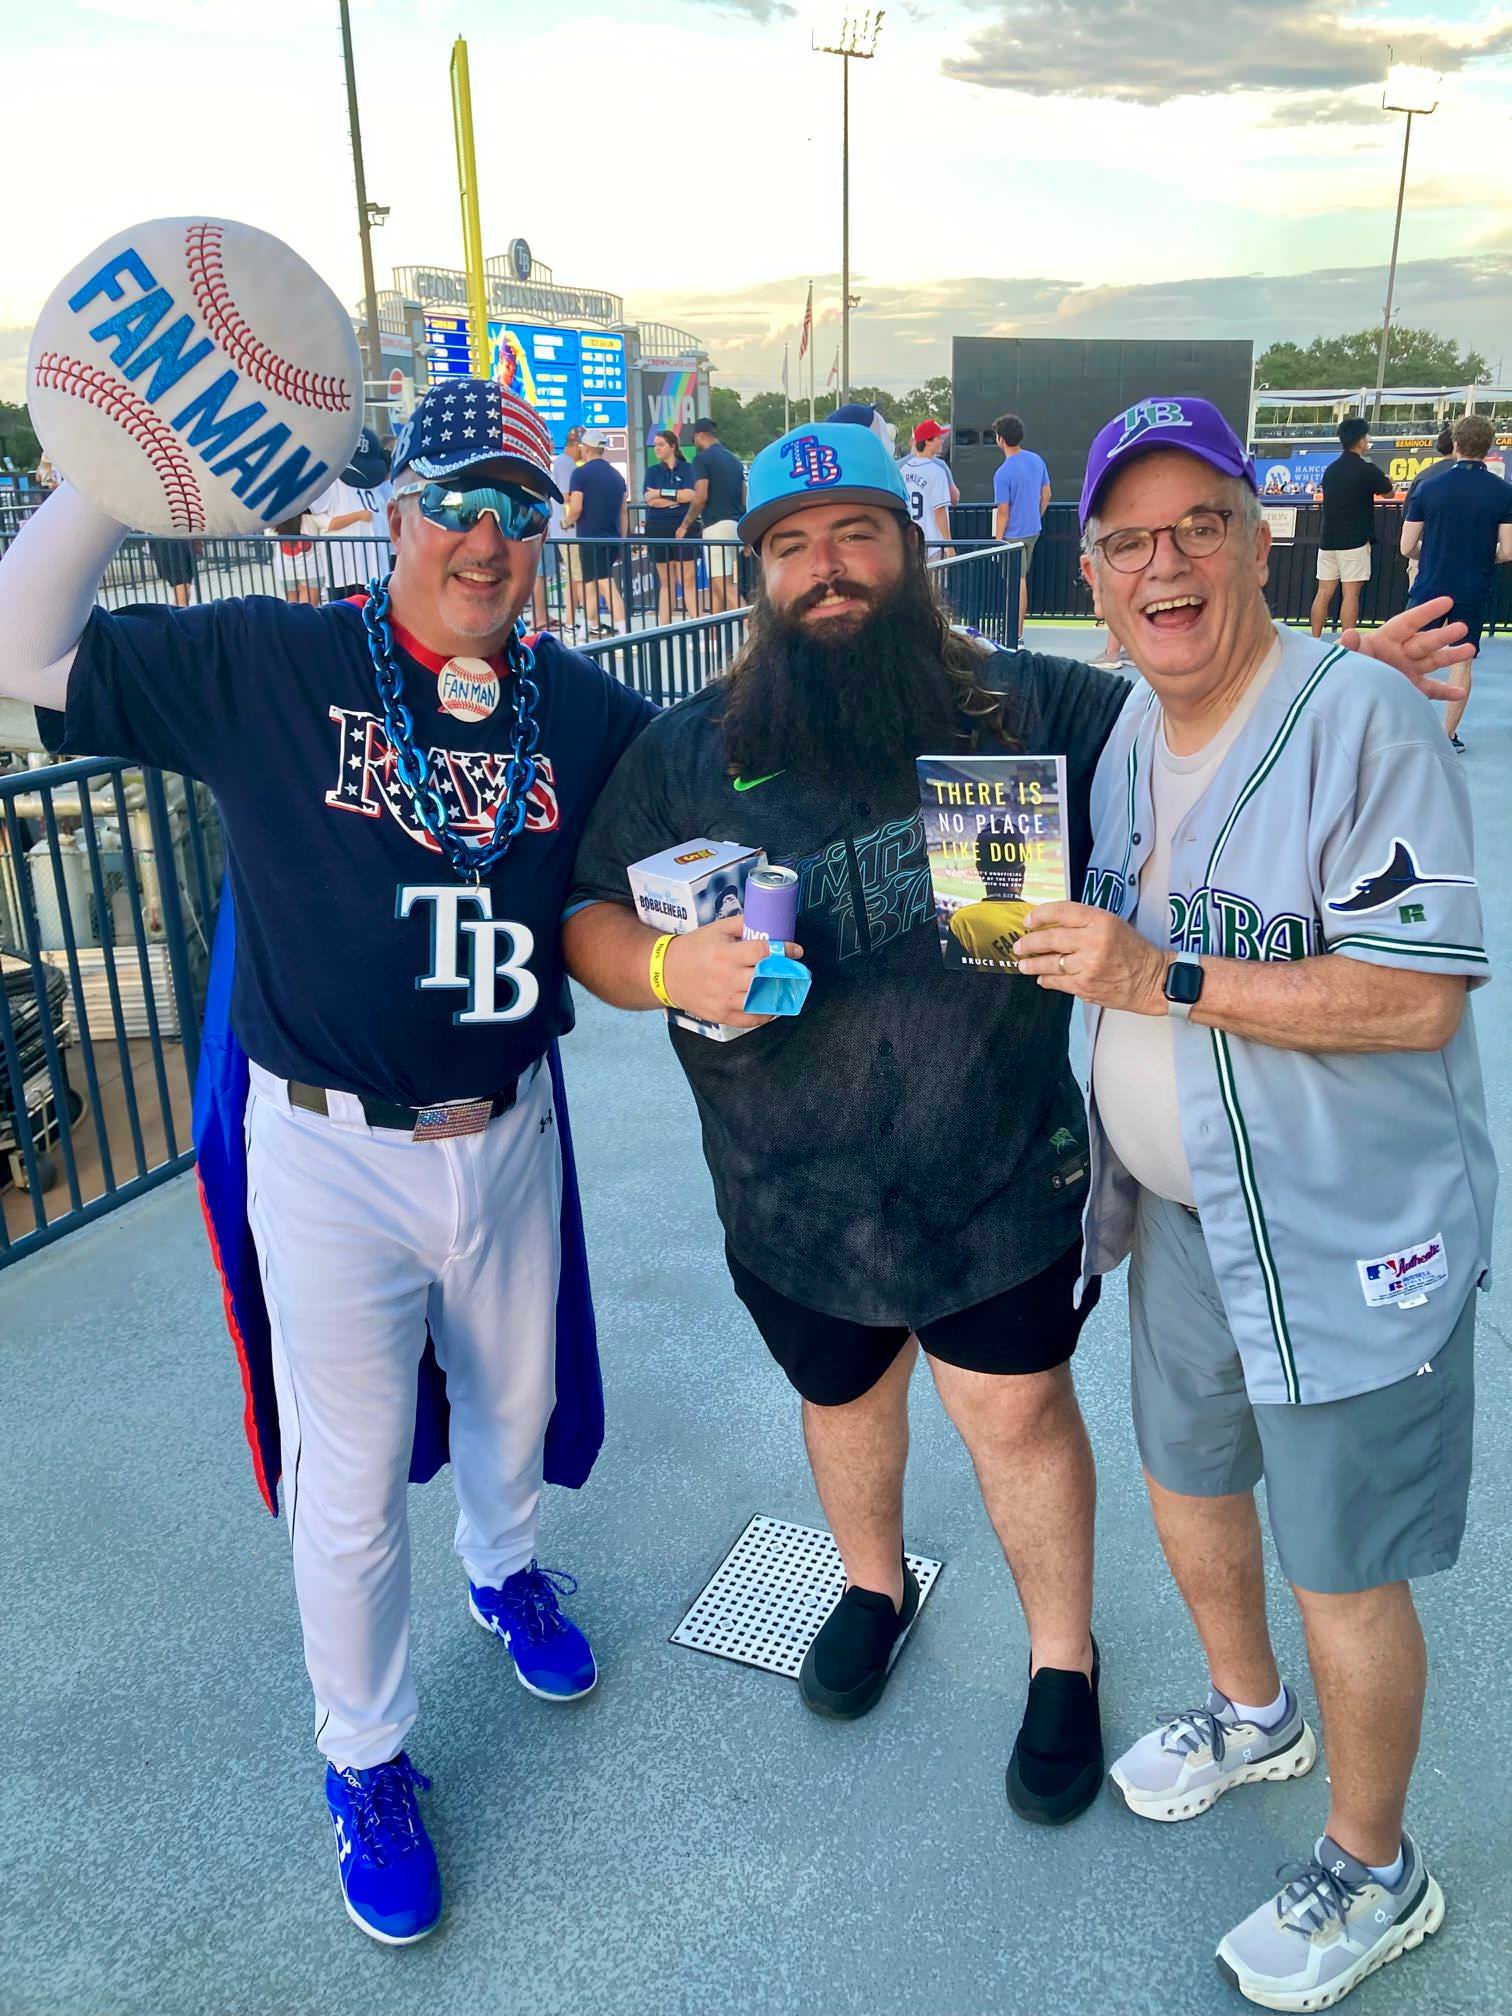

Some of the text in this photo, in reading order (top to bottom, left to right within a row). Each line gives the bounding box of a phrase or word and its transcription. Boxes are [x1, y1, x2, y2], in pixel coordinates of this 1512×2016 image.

[415, 271, 467, 303] GEORG
[68, 248, 328, 522] FAN MAN
[647, 394, 696, 425] VIVA
[780, 435, 842, 488] TB
[1389, 457, 1441, 481] GM
[911, 491, 924, 520] 9
[443, 672, 497, 708] FAN MAN
[934, 782, 1043, 805] THERE IS
[939, 812, 1044, 834] NO PLACE
[942, 840, 1044, 862] LIKE DOME
[640, 895, 688, 921] BOBBLEHEAD
[394, 884, 540, 1025] TB
[961, 957, 1019, 968] BRUCE REY
